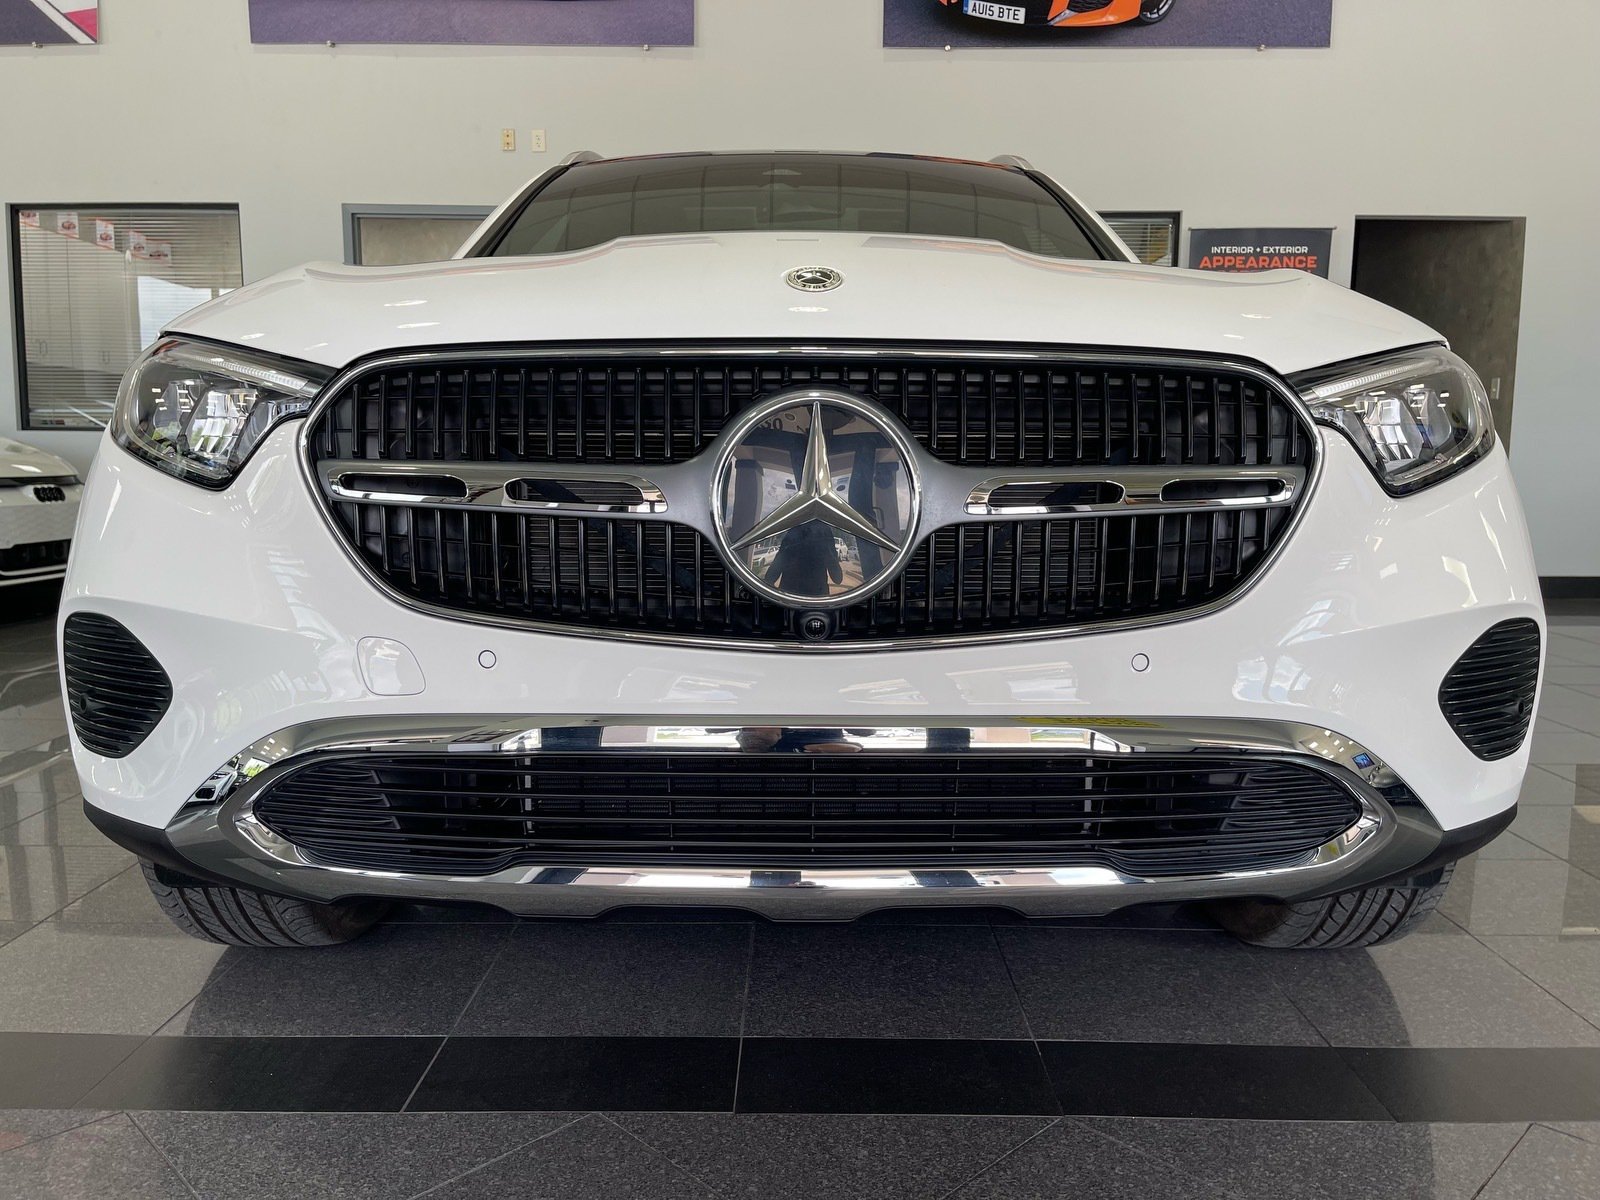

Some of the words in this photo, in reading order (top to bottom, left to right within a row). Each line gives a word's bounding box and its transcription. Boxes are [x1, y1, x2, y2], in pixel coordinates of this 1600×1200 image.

[971, 2, 995, 17] AU15
[997, 6, 1021, 21] BTE
[1211, 246, 1254, 254] INTERIOR
[1262, 246, 1309, 254] EXTERIOR
[1199, 255, 1318, 269] APPEARANCE
